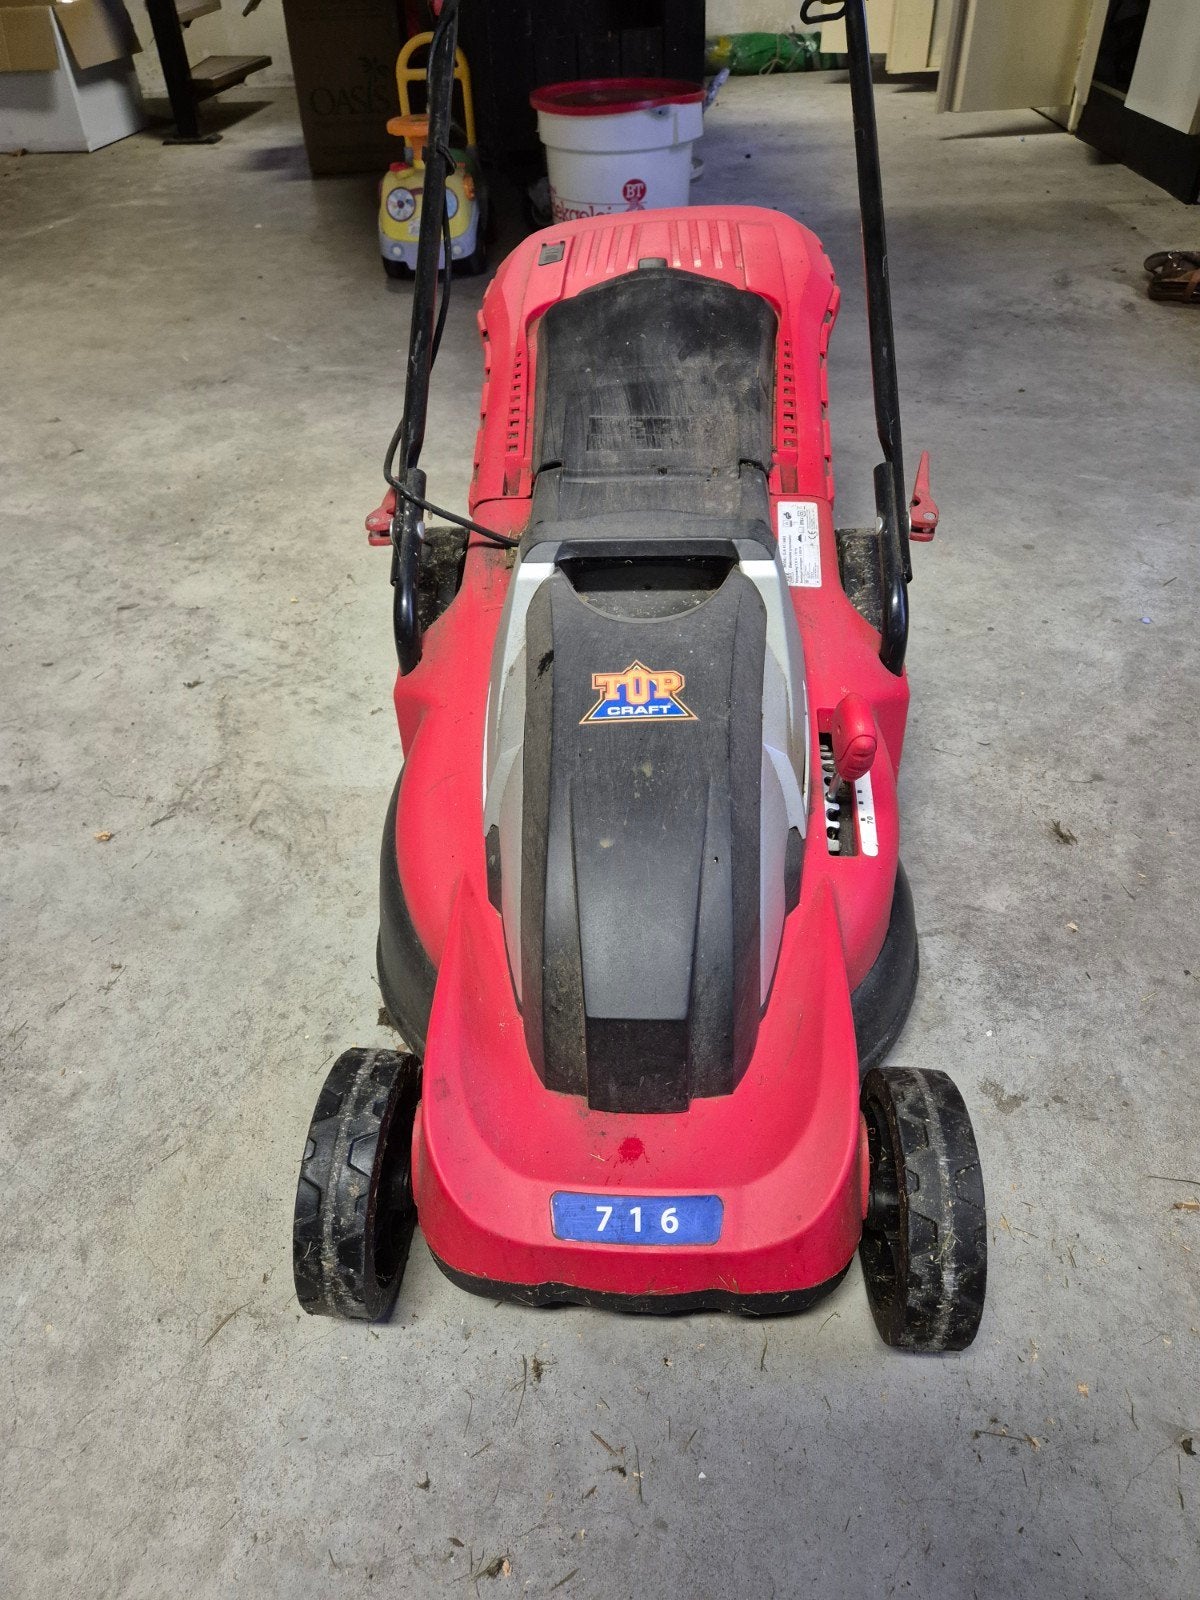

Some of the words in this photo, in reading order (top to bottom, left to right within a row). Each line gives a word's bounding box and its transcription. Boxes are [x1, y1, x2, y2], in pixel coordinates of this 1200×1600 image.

[626, 183, 645, 199] BT
[594, 667, 682, 705] TOP
[607, 705, 671, 716] CRAFT
